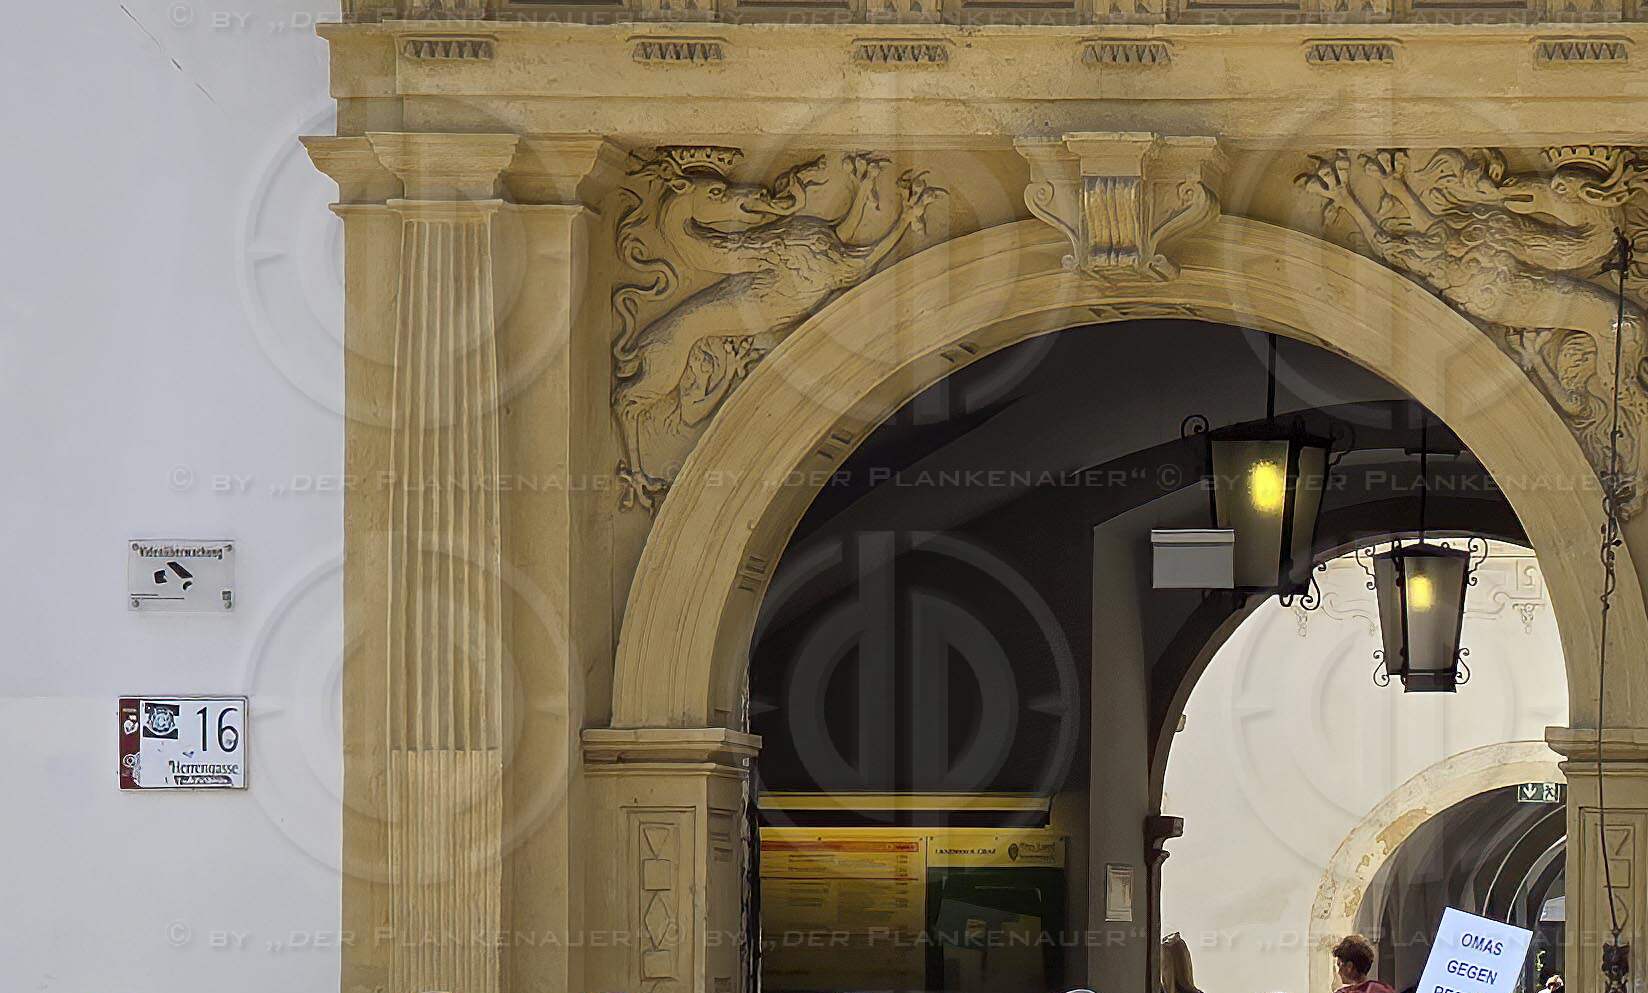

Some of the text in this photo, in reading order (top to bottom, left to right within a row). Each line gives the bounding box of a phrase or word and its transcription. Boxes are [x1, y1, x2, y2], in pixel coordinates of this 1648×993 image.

[196, 706, 239, 752] 16
[169, 760, 239, 775] Herrengasse
[1461, 933, 1504, 956] OMAS
[1447, 960, 1498, 985] GEGEN
